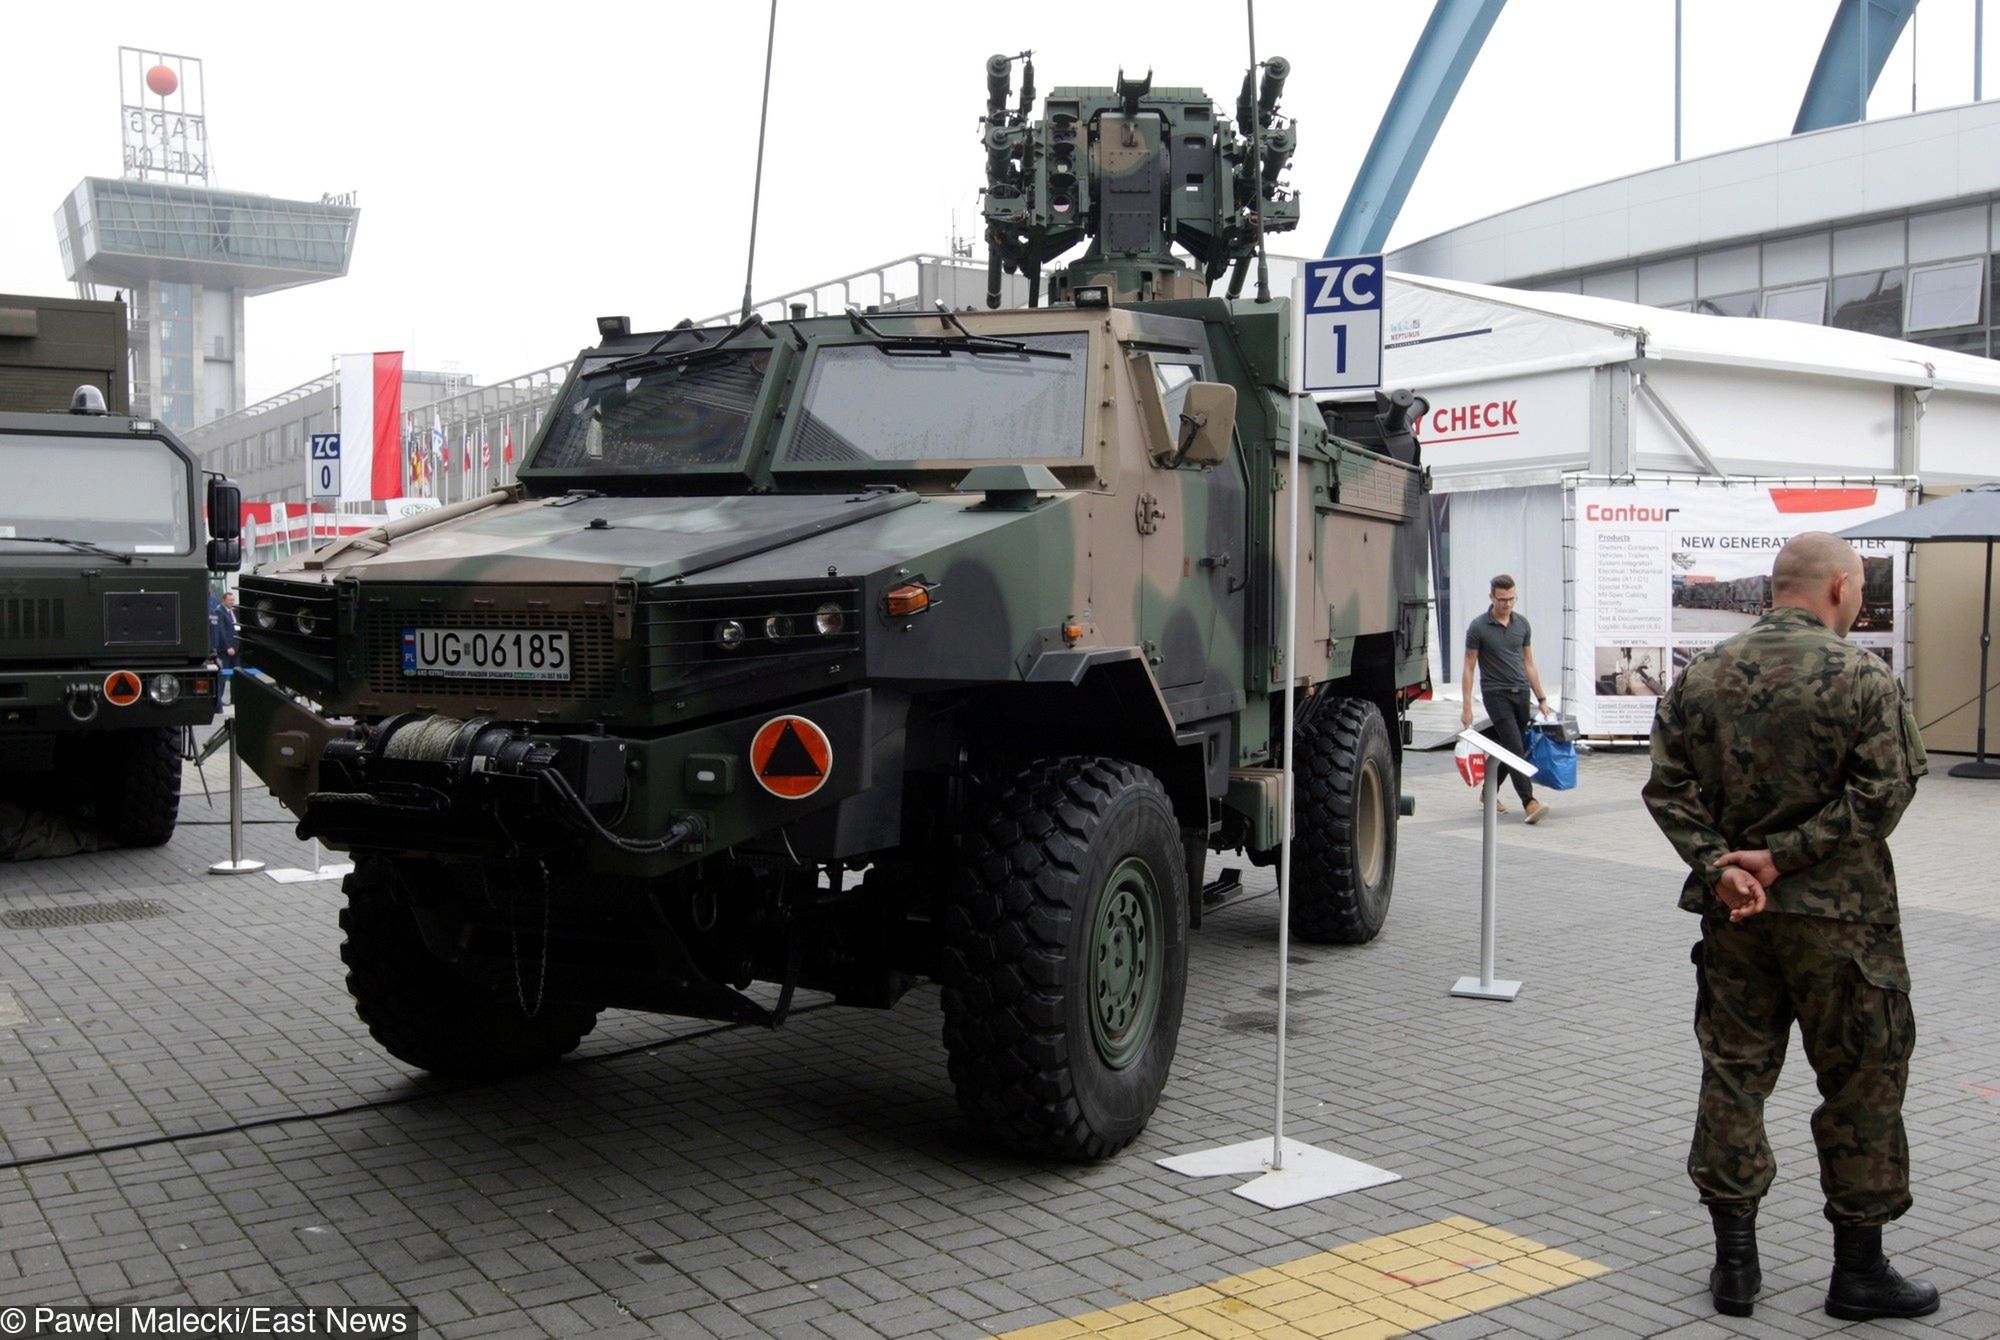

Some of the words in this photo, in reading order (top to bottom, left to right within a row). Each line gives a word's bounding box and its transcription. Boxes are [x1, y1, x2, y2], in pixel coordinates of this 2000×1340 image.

[1313, 263, 1376, 308] ZC
[1333, 324, 1347, 374] 1
[1432, 400, 1518, 433] CHECK
[314, 436, 338, 458] ZC
[321, 464, 331, 489] 0
[1586, 504, 1680, 522] Contour
[1598, 534, 1631, 542] Products
[1681, 536, 1715, 548] NEW
[1719, 536, 1789, 549] GENERAT
[404, 653, 415, 663] PL
[420, 632, 462, 666] UG
[472, 633, 565, 669] 06185
